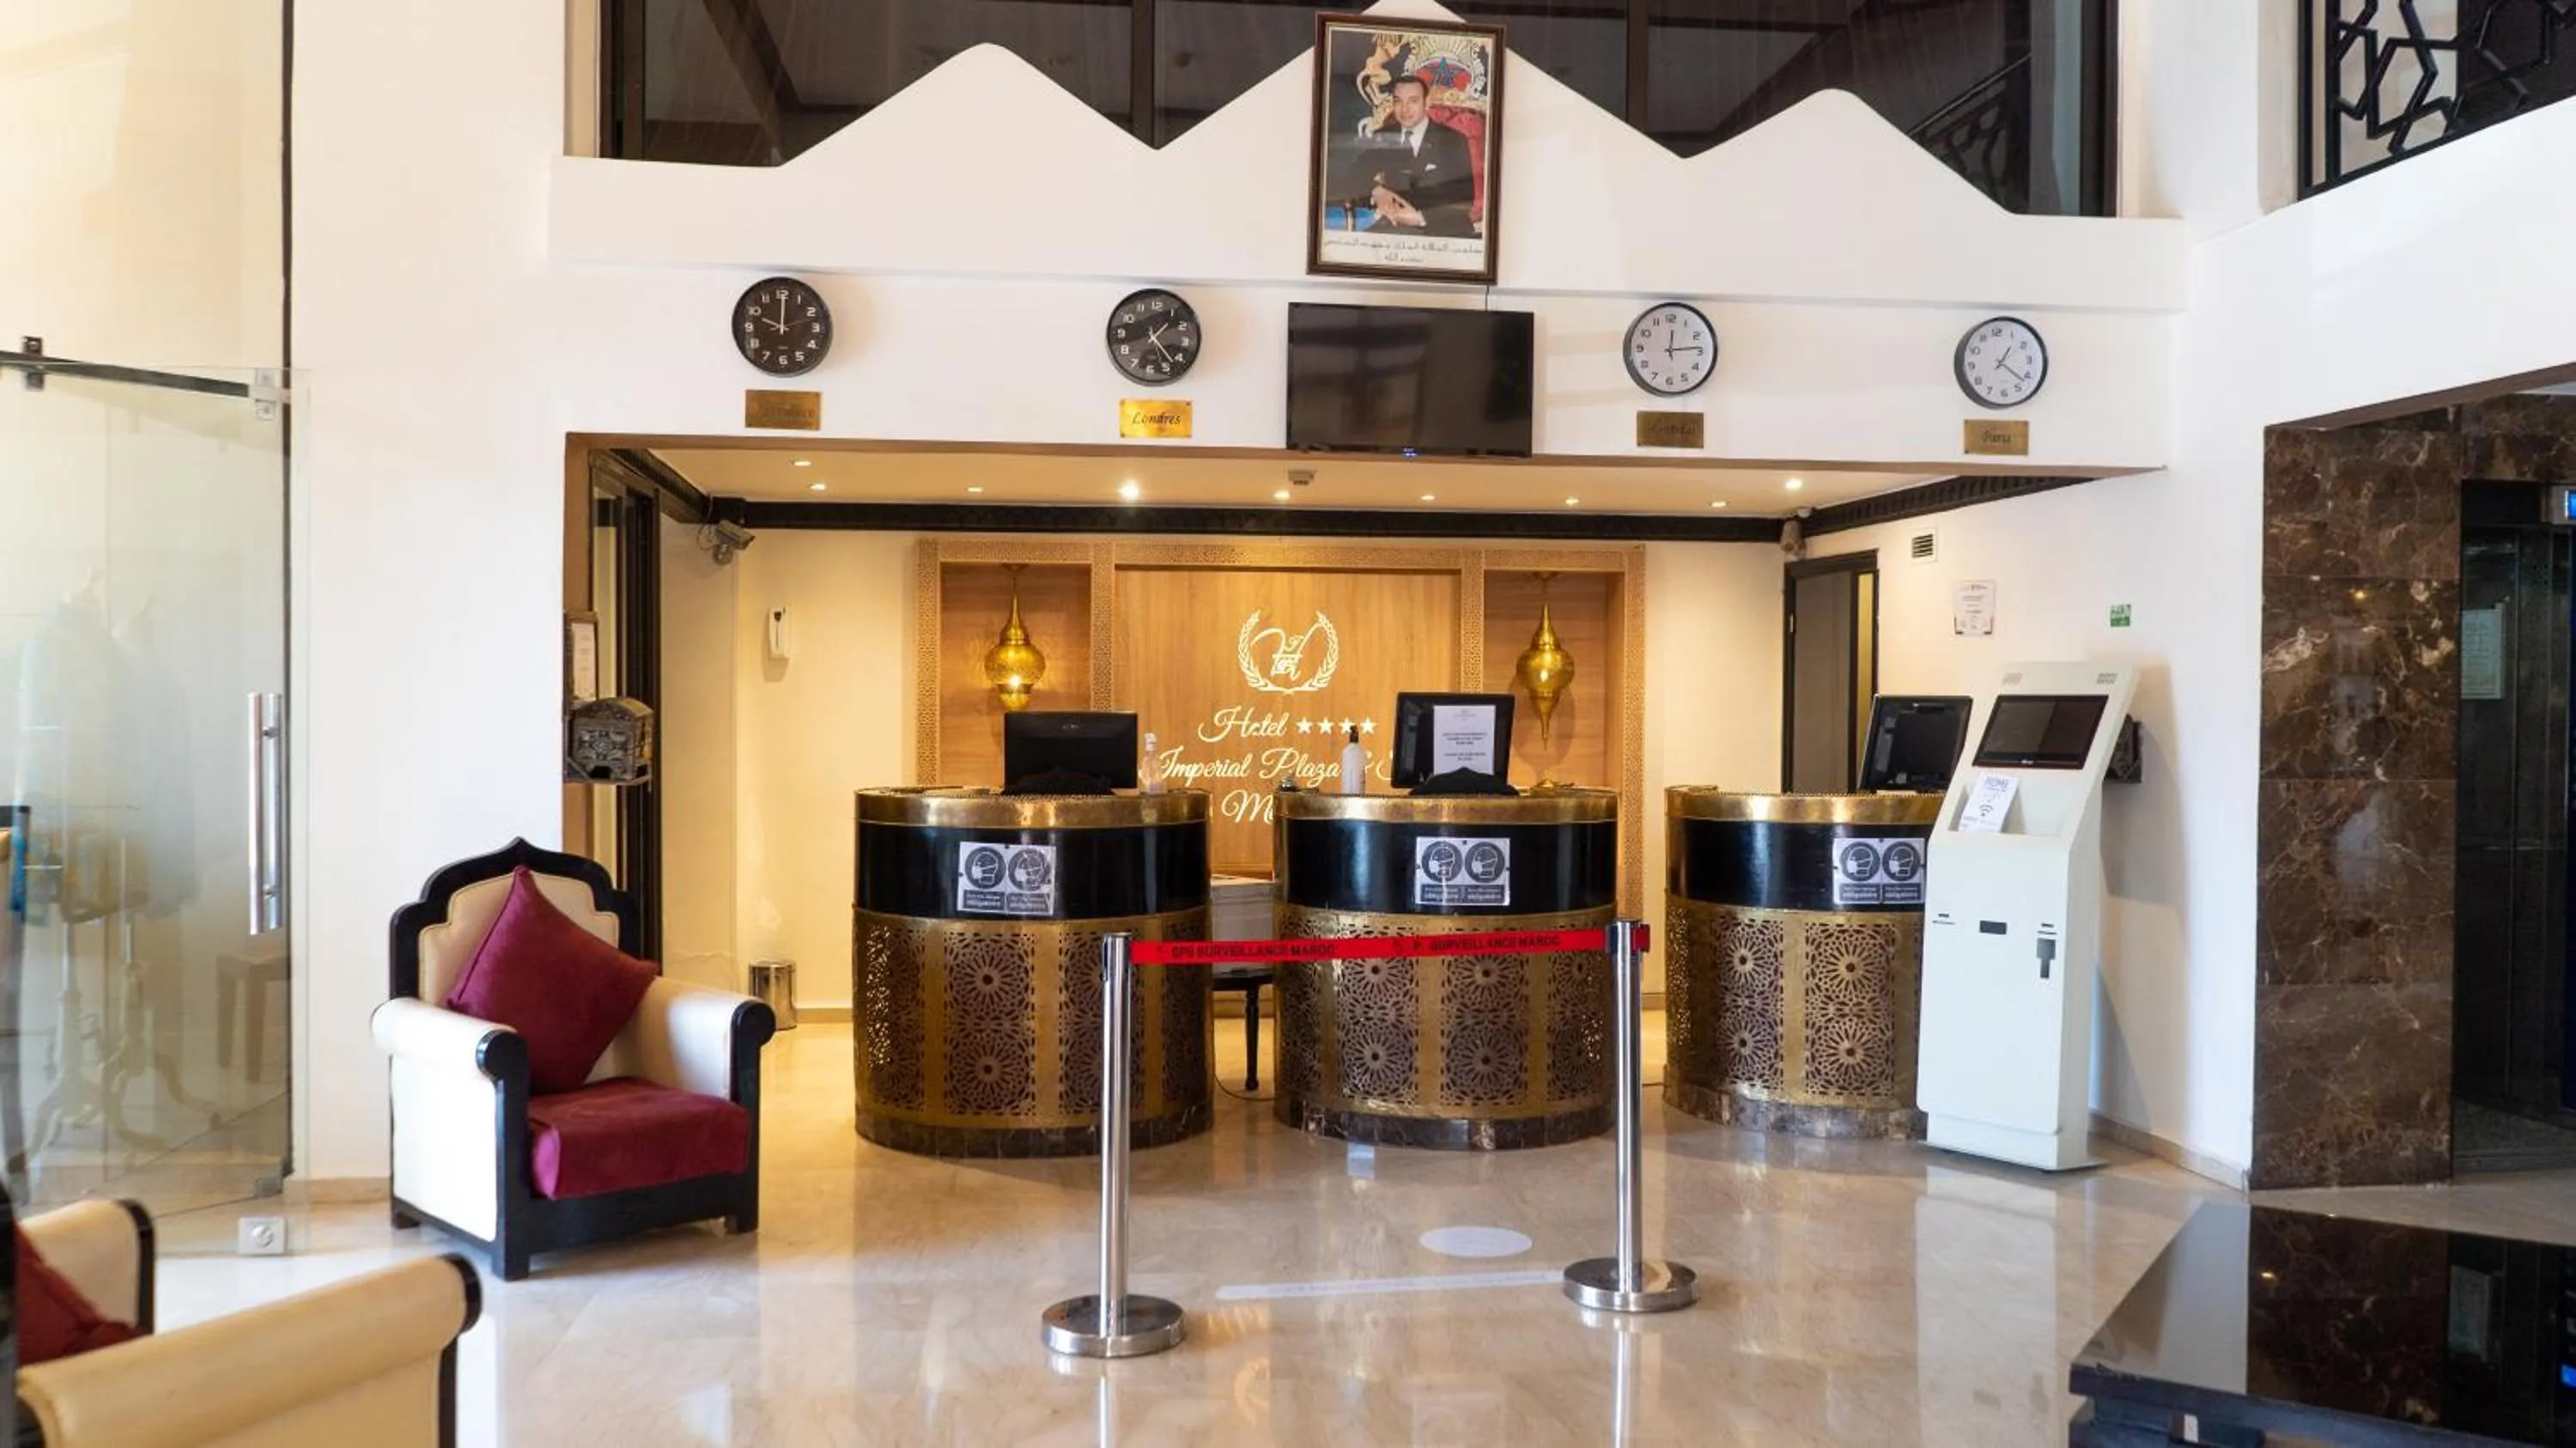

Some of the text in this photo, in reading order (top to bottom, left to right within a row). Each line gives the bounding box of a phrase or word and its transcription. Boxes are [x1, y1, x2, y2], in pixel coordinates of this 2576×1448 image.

[761, 292, 770, 303] 11
[746, 306, 762, 316] 10
[1137, 303, 1145, 312] 11
[1151, 301, 1163, 312] 12
[806, 307, 817, 317] 2
[1122, 313, 1134, 324] 10
[1653, 317, 1660, 327] 11
[1665, 313, 1677, 324] 12
[744, 322, 753, 332] 9
[811, 323, 820, 332] 3
[1178, 320, 1188, 331] 2
[1117, 328, 1126, 338] 9
[1640, 329, 1651, 338] 10
[1692, 331, 1701, 341] 2
[1991, 328, 2002, 338] 12
[807, 339, 817, 350] 4
[1181, 337, 1189, 347] 3
[1636, 344, 1644, 353] 9
[1969, 346, 1980, 356] 10
[762, 350, 770, 361] 7
[795, 351, 805, 362] 5
[1175, 353, 1184, 362] 4
[2026, 356, 2032, 365] 3
[1130, 358, 1139, 368] 7
[1162, 362, 1170, 372] 5
[1692, 362, 1699, 371] 4
[1967, 362, 1975, 370] 9
[1651, 371, 1659, 380] 7
[1680, 373, 1688, 382] 5
[2024, 370, 2032, 379] 4
[1987, 386, 1993, 395] 7
[2014, 383, 2021, 392] 5
[1132, 411, 1182, 425] Londres
[1198, 705, 1291, 743] Hotel
[1139, 745, 1253, 788] Imperial
[1259, 747, 1341, 788] Plaza
[1291, 944, 1335, 956] MAROC
